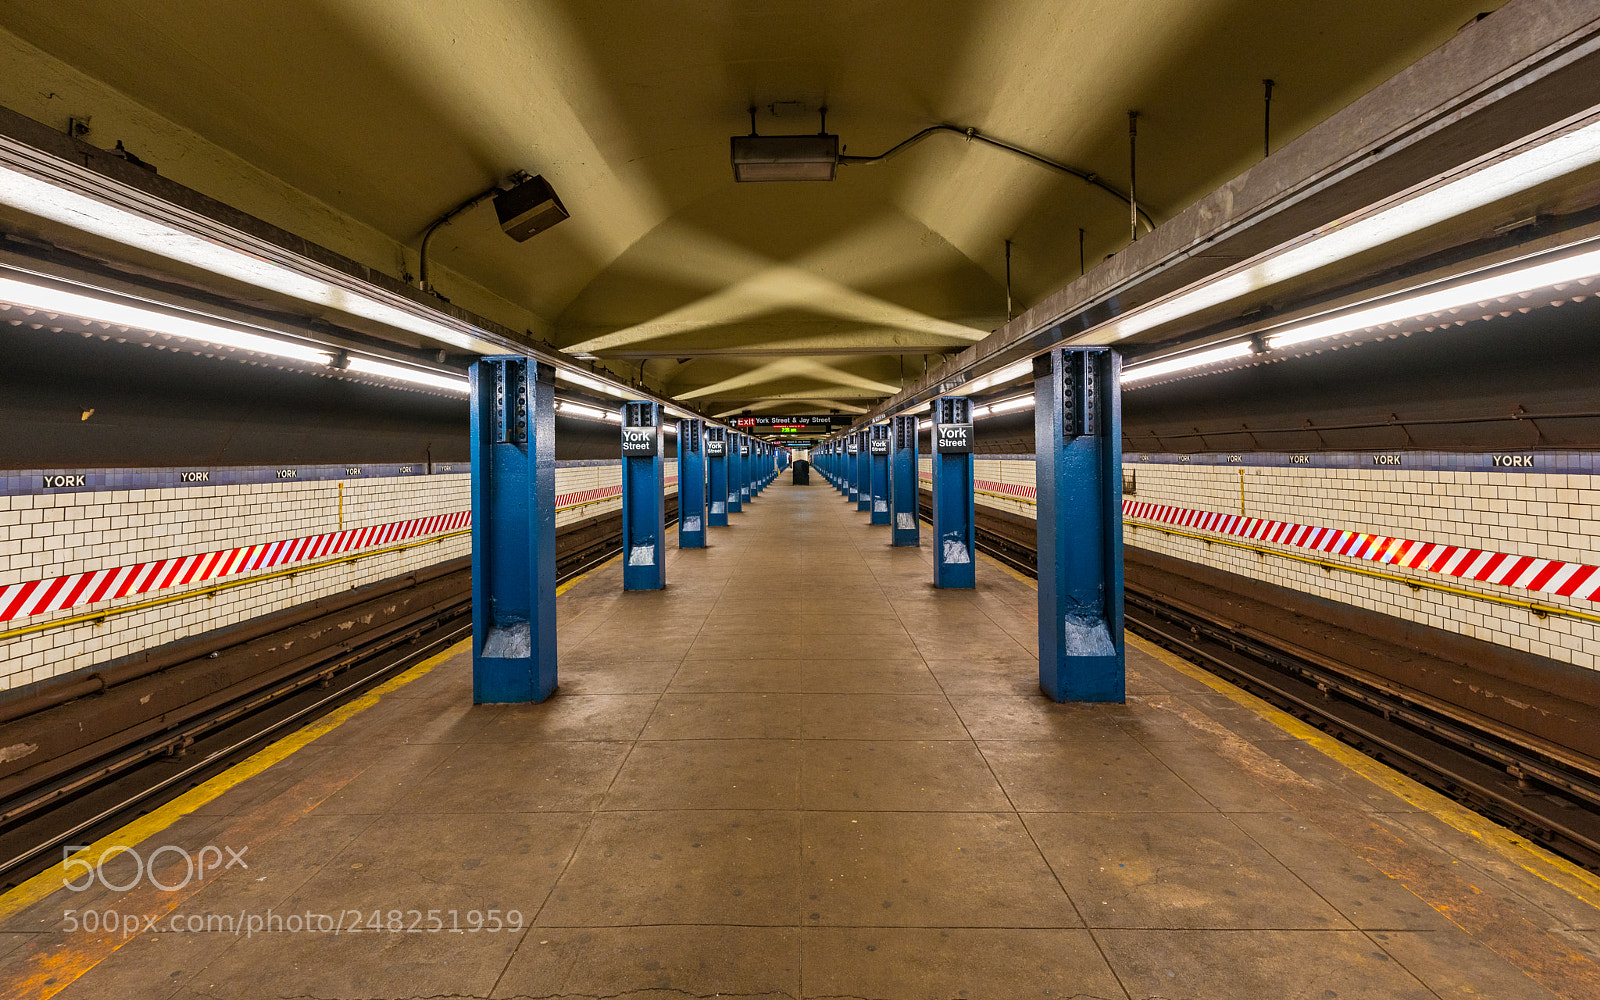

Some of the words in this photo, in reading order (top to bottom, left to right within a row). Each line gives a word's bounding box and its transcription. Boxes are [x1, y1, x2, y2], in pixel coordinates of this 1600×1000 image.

[737, 418, 755, 426] Exit
[799, 417, 810, 425] Jay
[623, 431, 650, 442] York
[938, 427, 967, 438] York
[623, 442, 650, 450] Street
[871, 440, 887, 448] York
[939, 439, 967, 447] Street
[1226, 455, 1243, 463] YORK
[1289, 455, 1310, 464] YORK
[1373, 455, 1401, 465] YORK
[1493, 455, 1533, 467] YORK
[276, 470, 297, 478] YORK
[345, 467, 362, 476] YORK
[44, 475, 86, 488] YORK
[181, 472, 209, 482] YORK
